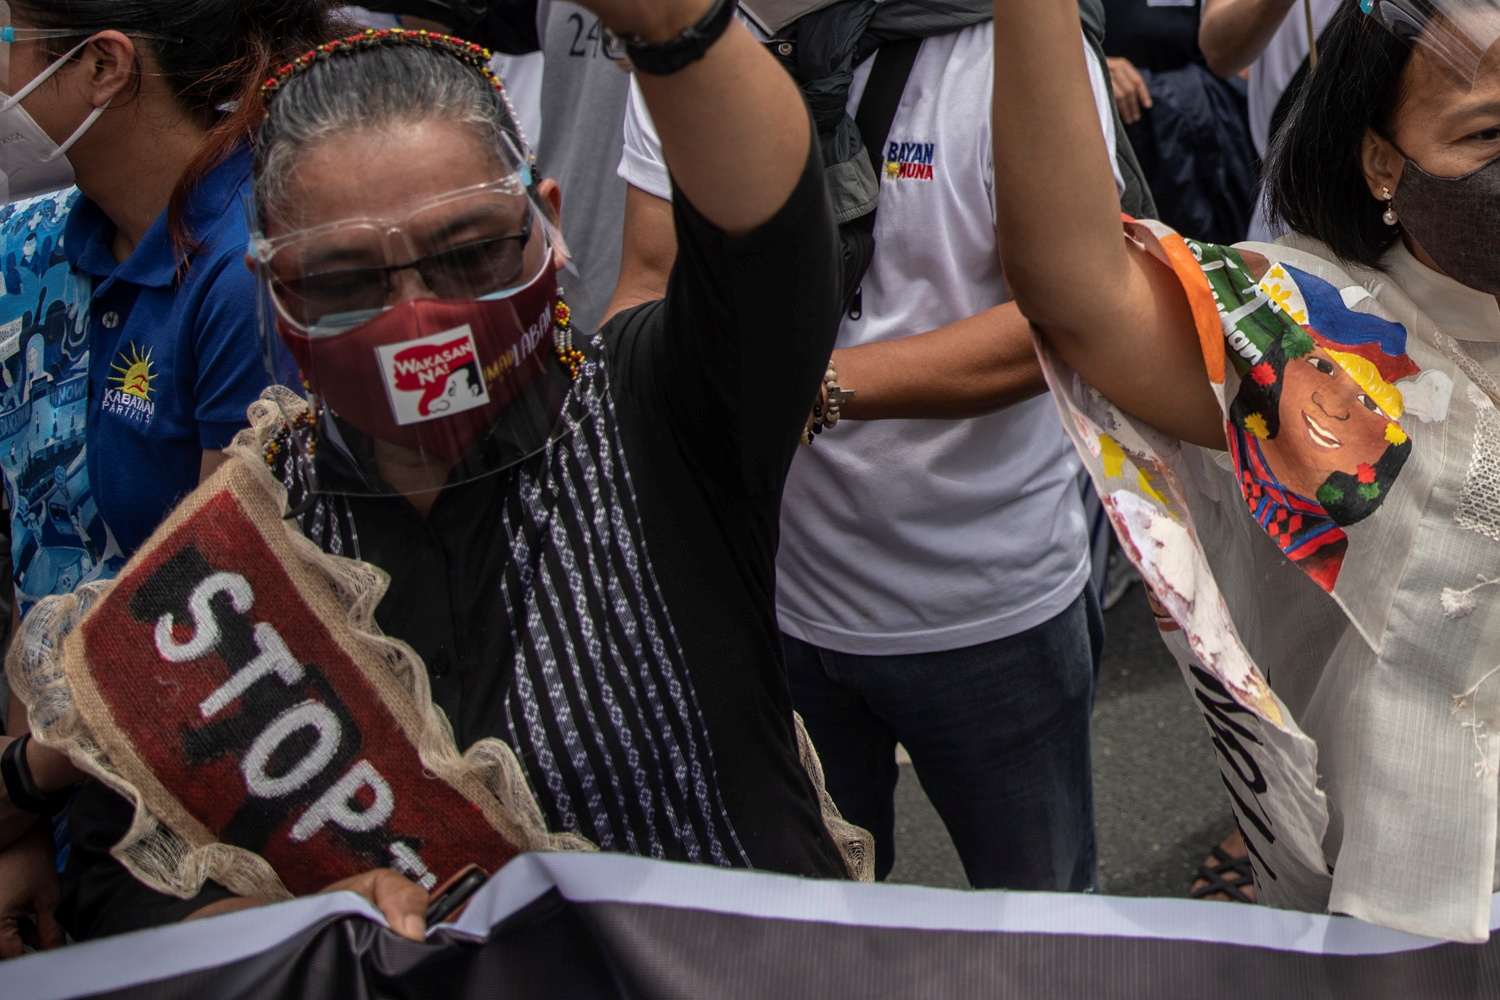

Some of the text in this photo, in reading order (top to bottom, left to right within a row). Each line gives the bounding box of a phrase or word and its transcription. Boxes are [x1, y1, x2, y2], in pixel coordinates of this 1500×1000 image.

[887, 141, 935, 164] BAYAN
[897, 162, 934, 180] MUNA
[396, 342, 473, 376] WAKASAN
[417, 363, 450, 386] NA!
[153, 571, 396, 842] STOP
